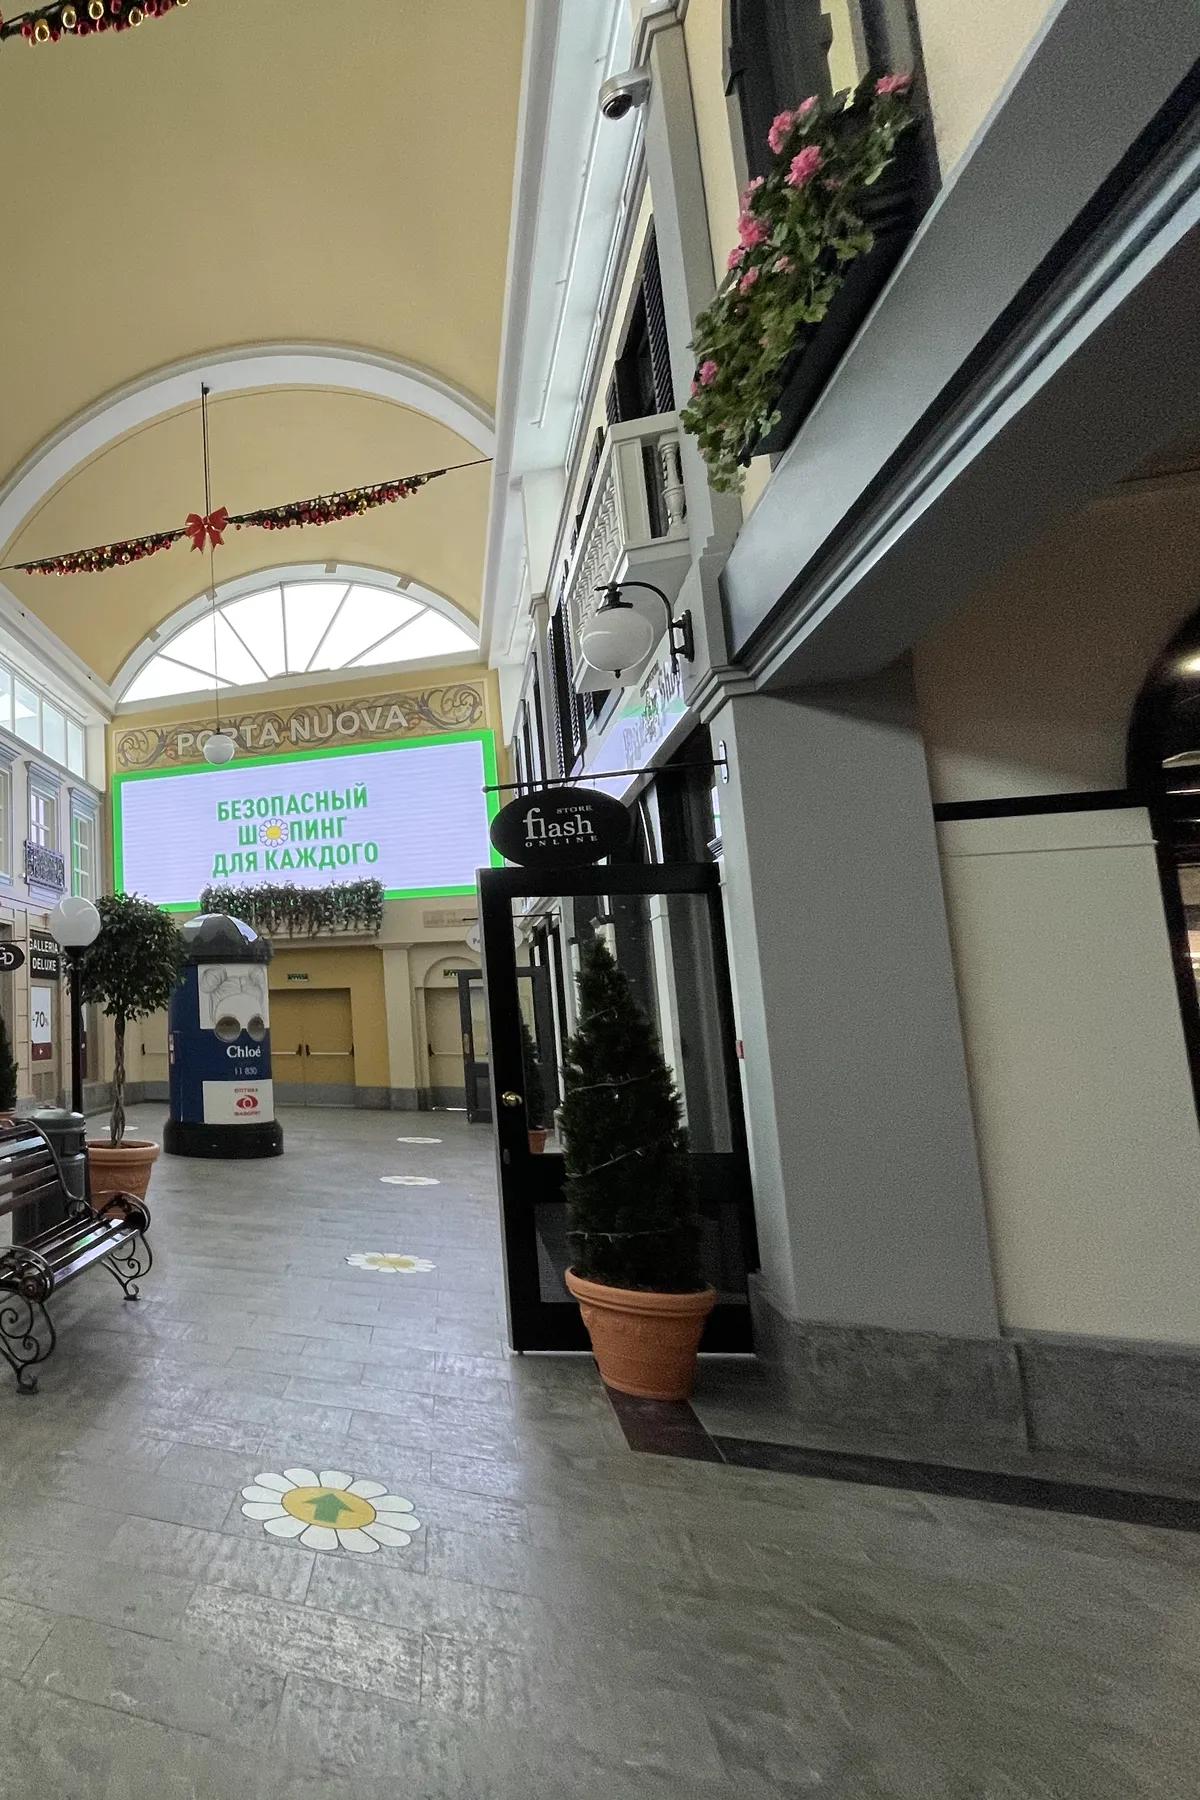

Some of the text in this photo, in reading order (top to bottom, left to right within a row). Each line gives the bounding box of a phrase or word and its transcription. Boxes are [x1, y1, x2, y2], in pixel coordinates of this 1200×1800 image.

[290, 704, 409, 741] NUOVA
[216, 782, 368, 821] БЕЗОПАСНЫЙ
[556, 805, 593, 814] STORE
[522, 807, 594, 840] flash
[525, 835, 598, 848] ONLINE
[212, 841, 379, 878] ДЛЯ КАЖДОГО
[30, 938, 59, 954] GALLERIA
[32, 957, 57, 971] DELUXE
[226, 1045, 262, 1058] Chloé
